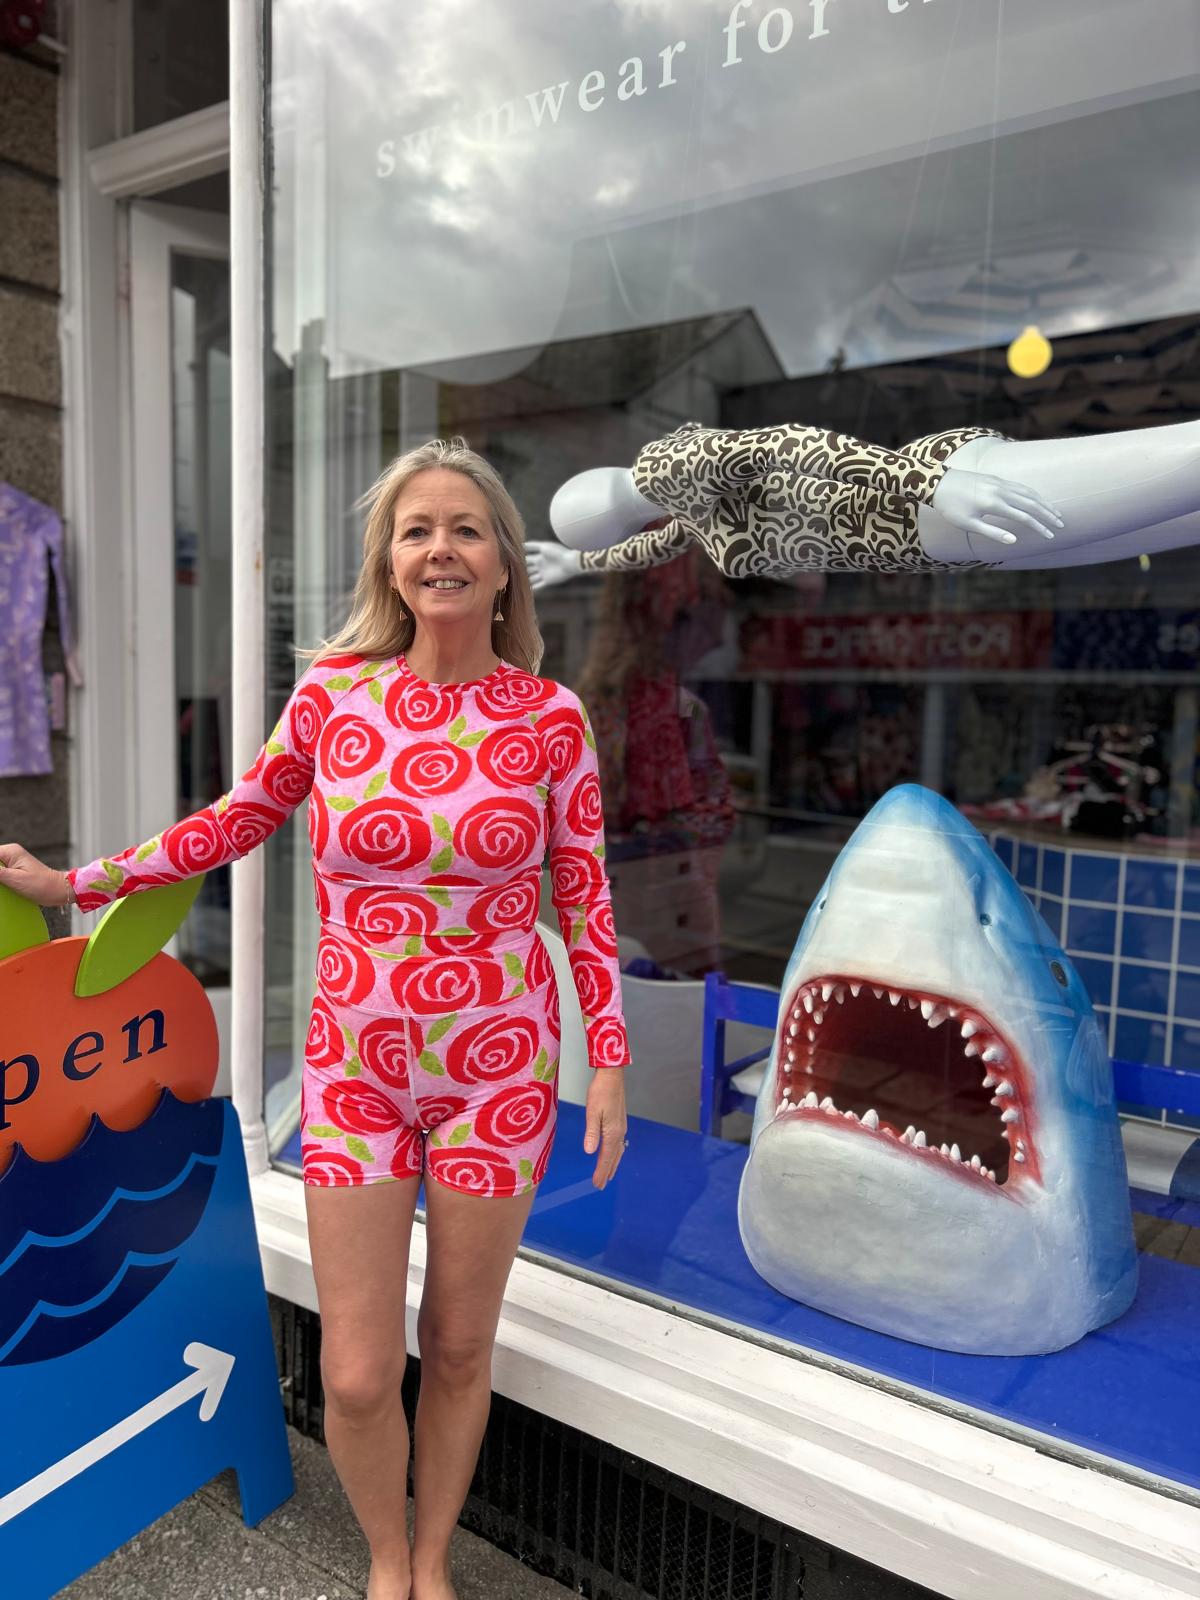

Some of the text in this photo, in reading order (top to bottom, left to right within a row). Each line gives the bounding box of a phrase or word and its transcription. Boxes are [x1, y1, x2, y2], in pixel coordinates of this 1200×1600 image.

[375, 0, 830, 178] swimwear for
[0, 1009, 167, 1130] pen
